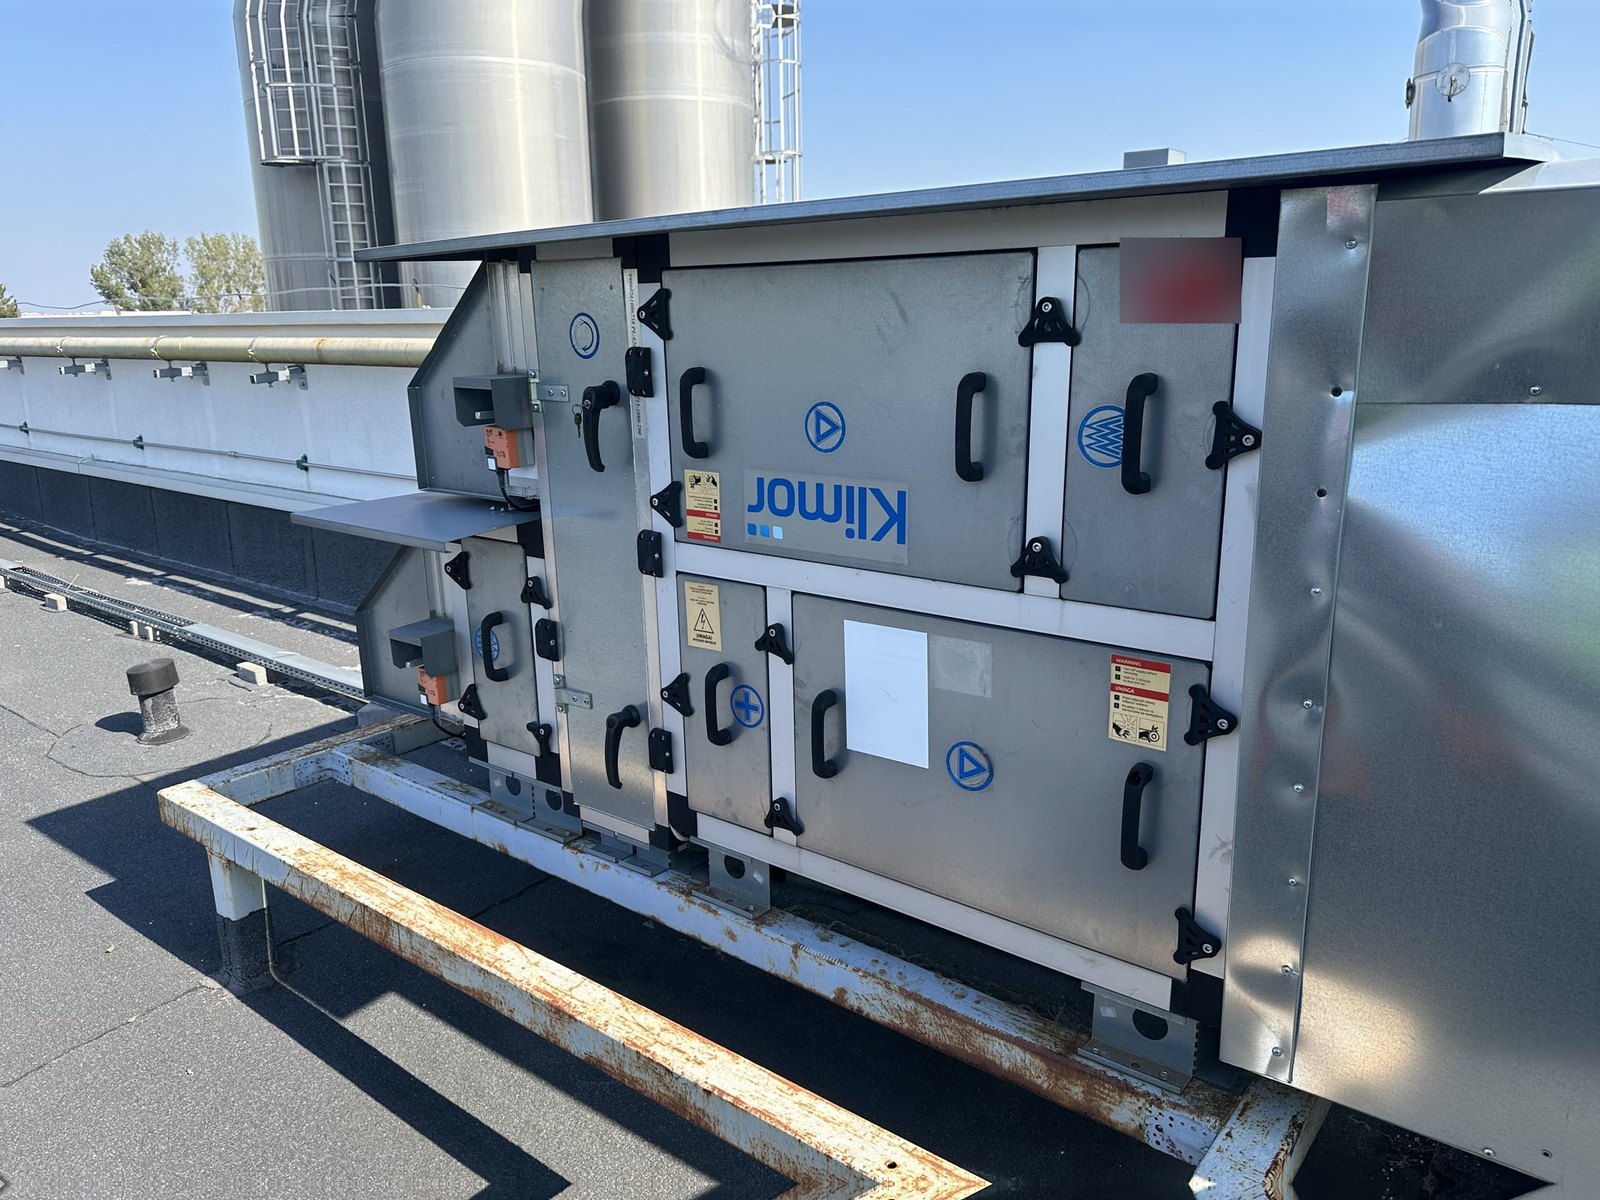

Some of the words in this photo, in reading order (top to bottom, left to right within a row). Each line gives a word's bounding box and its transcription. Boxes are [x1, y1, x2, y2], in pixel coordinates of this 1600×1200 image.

[747, 477, 907, 545] Klimor
[1115, 658, 1142, 666] WARNING
[1114, 685, 1135, 694] UWAGA
